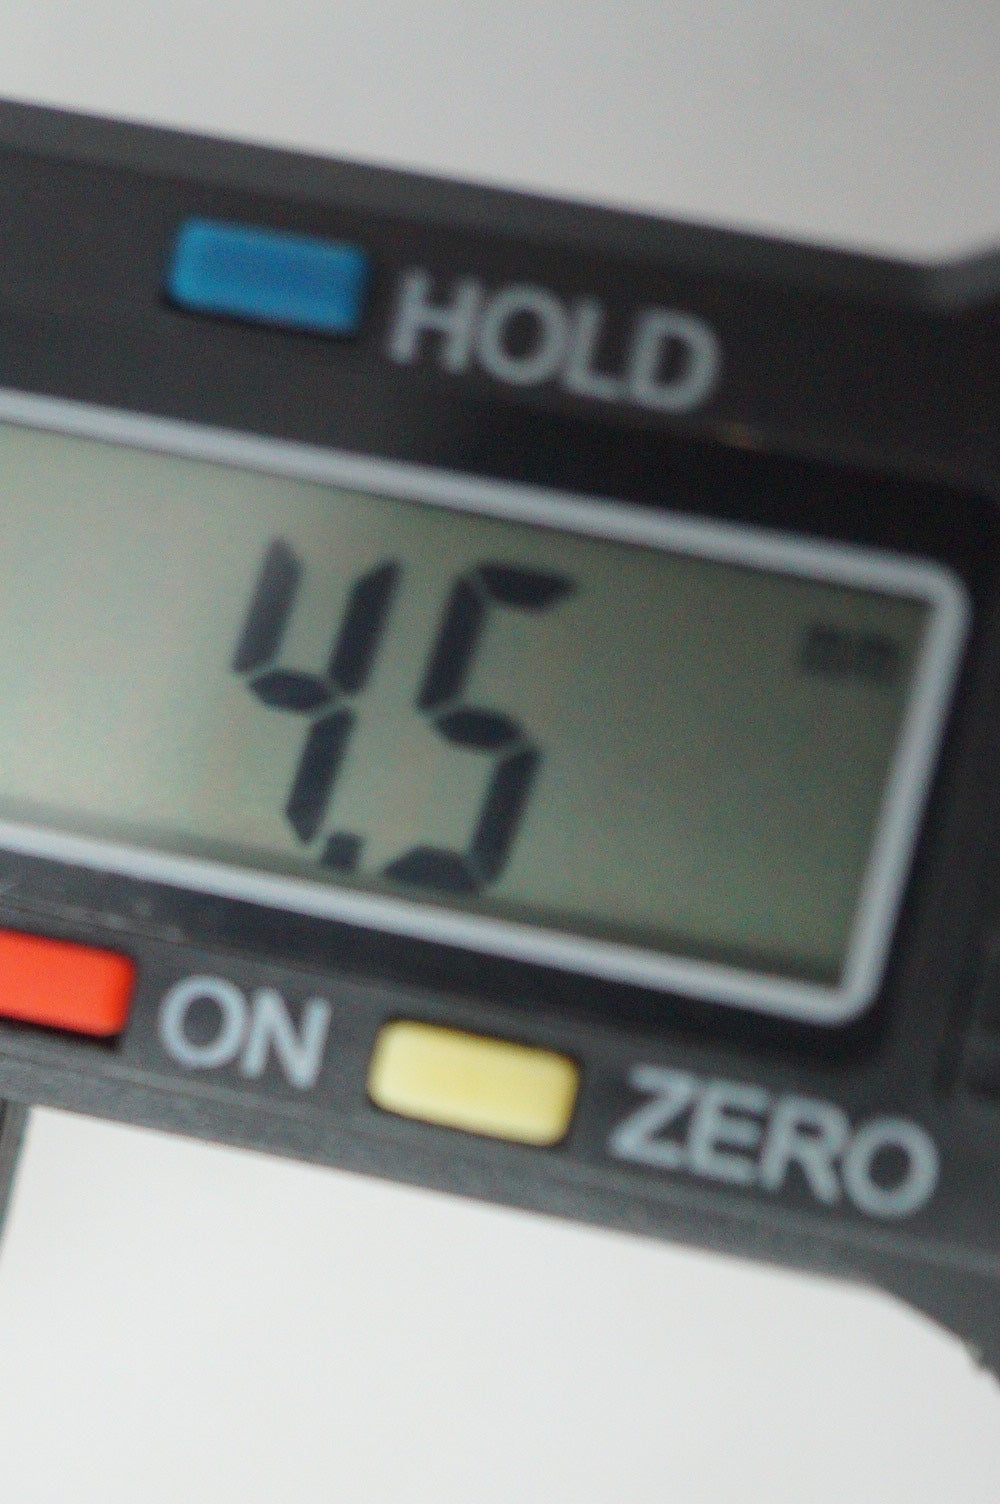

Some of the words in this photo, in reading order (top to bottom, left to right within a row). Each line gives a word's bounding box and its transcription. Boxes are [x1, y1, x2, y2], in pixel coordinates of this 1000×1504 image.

[387, 268, 722, 413] HOLD
[232, 536, 577, 895] 4.5
[158, 975, 333, 1091] ON
[608, 1062, 942, 1220] ZERO
